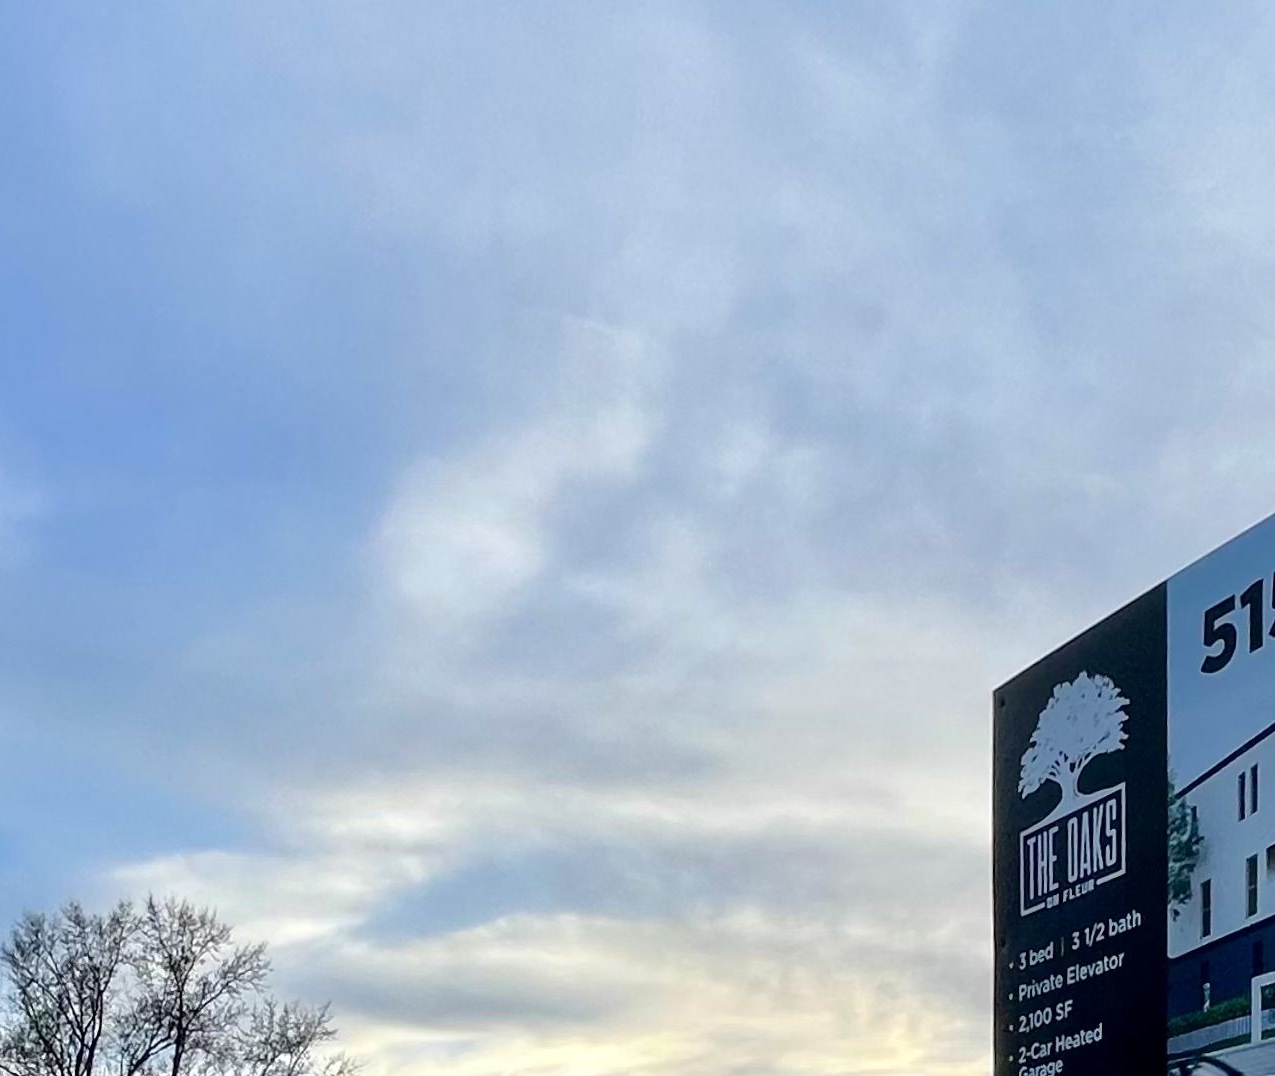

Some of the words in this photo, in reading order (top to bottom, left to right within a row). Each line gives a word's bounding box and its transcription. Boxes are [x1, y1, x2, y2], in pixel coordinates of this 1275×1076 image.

[1026, 825, 1060, 900] THE
[1067, 798, 1117, 883] OAKS
[1062, 878, 1095, 903] FLEUR
[1019, 952, 1027, 971] 3
[1029, 941, 1054, 966] bed
[1071, 931, 1080, 950] 3
[1084, 922, 1106, 948] 1/2
[1108, 909, 1142, 937] bath
[1018, 974, 1063, 1002] Private
[1067, 952, 1125, 985] Elevator
[1018, 1006, 1053, 1033] 2,100
[1055, 999, 1074, 1022] SF
[1018, 1041, 1053, 1064] 2-Car
[1055, 1022, 1103, 1053] Heated
